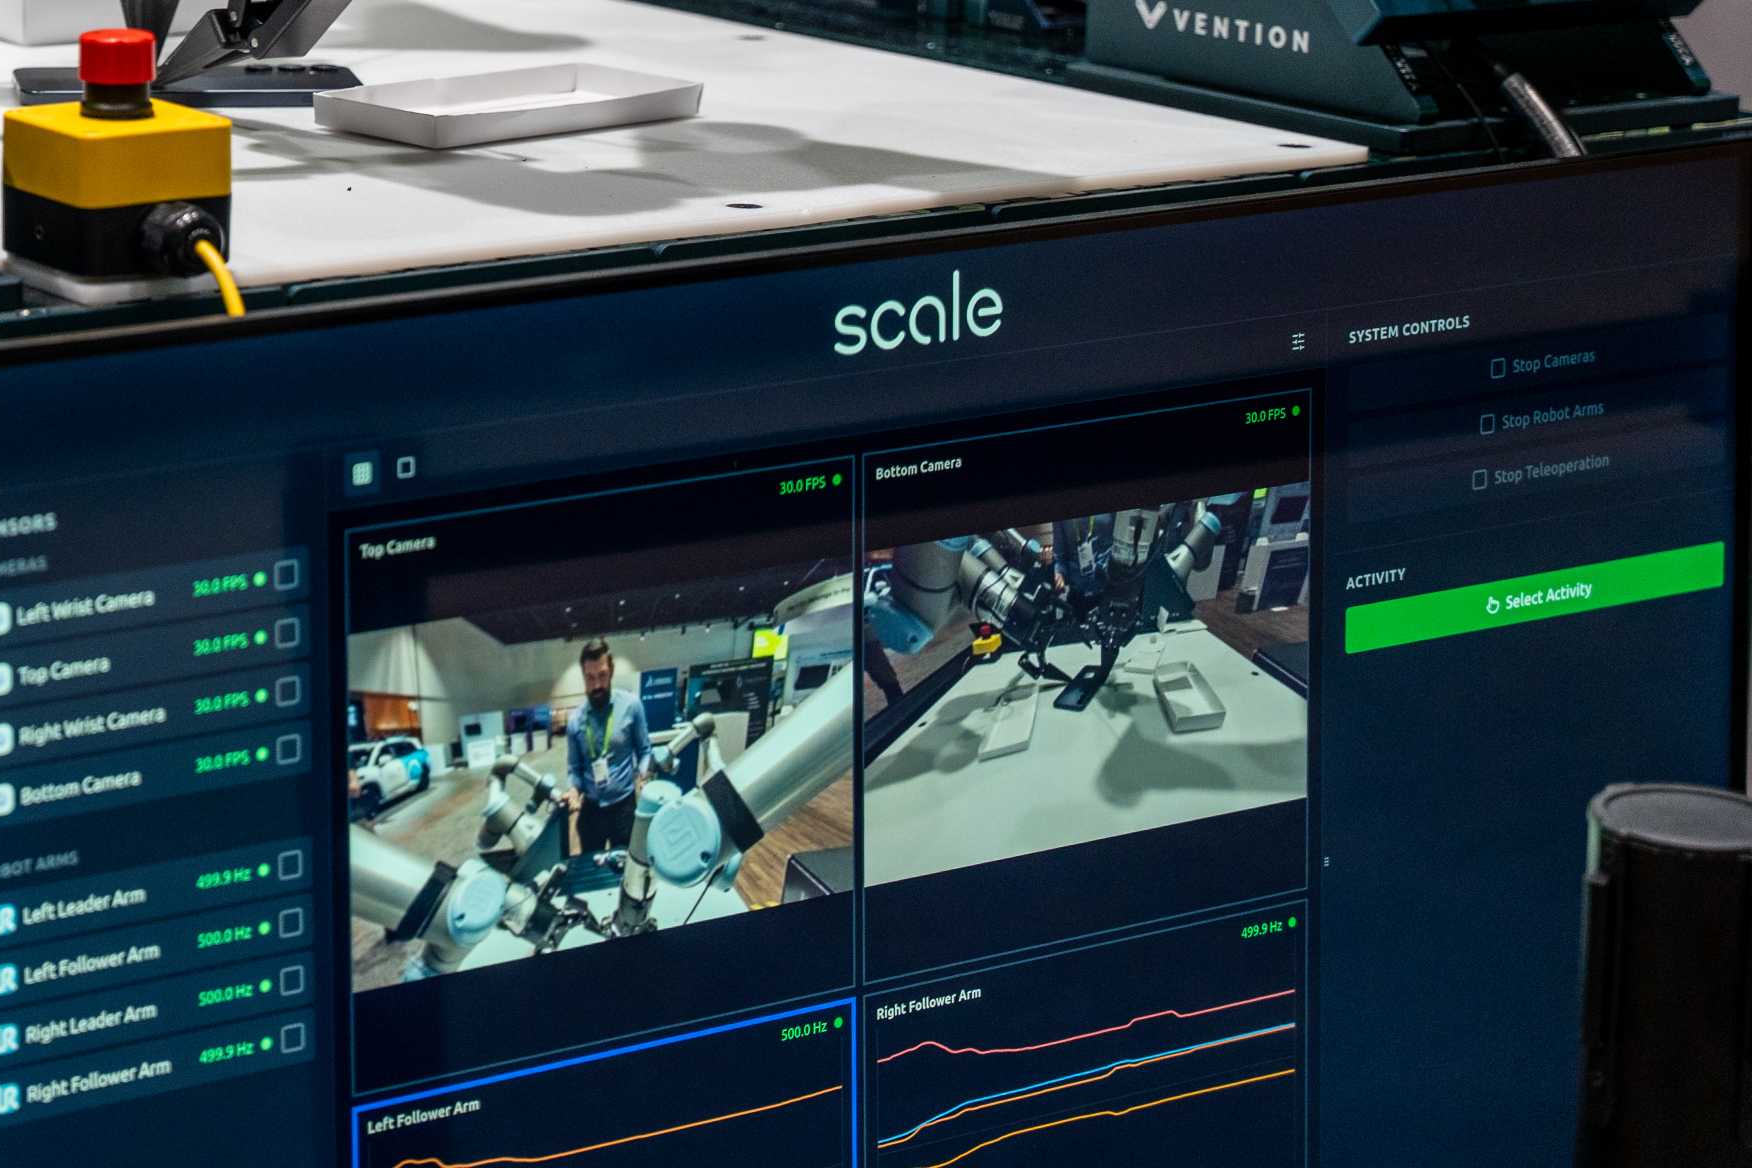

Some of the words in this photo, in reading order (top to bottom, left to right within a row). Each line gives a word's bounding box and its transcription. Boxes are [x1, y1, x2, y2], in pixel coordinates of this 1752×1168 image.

[1172, 8, 1310, 54] VENTION
[833, 269, 1003, 356] scale
[1349, 325, 1399, 344] SYSTEM
[1402, 315, 1470, 336] CONTROLS
[1512, 358, 1541, 374] Stop
[1544, 350, 1596, 368] Cameras
[1245, 410, 1266, 424] 30.0
[1267, 407, 1287, 421] FPS
[1502, 414, 1530, 430] Stop
[1533, 406, 1570, 424] Robot
[1572, 402, 1604, 418] Arms
[876, 465, 919, 480] Bottom
[920, 456, 962, 475] Camera
[1495, 469, 1522, 486] Stop
[1526, 454, 1611, 479] Teleoperation
[779, 479, 804, 496] 30.0
[805, 474, 827, 492] FPS
[359, 540, 384, 561] Top
[386, 534, 436, 556] Camera
[192, 576, 220, 598] 30.0
[221, 573, 248, 592] FPS
[1346, 568, 1406, 590] ACTIVITY
[16, 601, 50, 627] Left
[51, 596, 95, 621] Wrist
[95, 590, 156, 615] Camera
[1505, 592, 1543, 610] Select
[1545, 583, 1593, 602] Activity
[193, 635, 220, 656] 30.0
[221, 632, 248, 650] FPS
[18, 664, 49, 686] Top
[50, 657, 111, 681] Camera
[194, 695, 222, 715] 30.0
[222, 691, 250, 710] FPS
[18, 719, 62, 747] Right
[63, 713, 105, 737] Wrist
[106, 707, 166, 731] Camera
[195, 754, 224, 774] 30.0
[224, 749, 251, 768] FPS
[20, 778, 81, 807] Bottom
[81, 770, 143, 795] Camera
[35, 851, 78, 872] ARMS
[196, 871, 232, 890] 499.9
[234, 867, 253, 883] Hz
[22, 902, 56, 927] Left
[57, 892, 110, 919] Leader
[111, 887, 147, 909] Arm
[197, 930, 232, 949] 500.0
[234, 925, 253, 941] Hz
[1242, 922, 1268, 939] 499.9
[1270, 919, 1282, 934] Hz
[24, 961, 58, 986] Left
[59, 949, 125, 975] Follower
[126, 944, 161, 965] Arm
[198, 988, 233, 1007] 500.0
[235, 983, 254, 999] Hz
[876, 1003, 906, 1022] Right
[908, 992, 957, 1015] Follower
[957, 986, 982, 1004] Arm
[25, 1020, 68, 1047] Right
[69, 1010, 122, 1035] Leader
[123, 1003, 157, 1024] Arm
[781, 1026, 809, 1043] 500.0
[811, 1020, 827, 1035] Hz
[199, 1046, 235, 1064] 499.9
[236, 1041, 255, 1057] Hz
[26, 1080, 70, 1105] Right
[71, 1067, 137, 1094] Follower
[138, 1058, 172, 1079] Arm
[367, 1117, 394, 1137] Left
[395, 1104, 452, 1130] Follower
[452, 1098, 480, 1117] Arm
